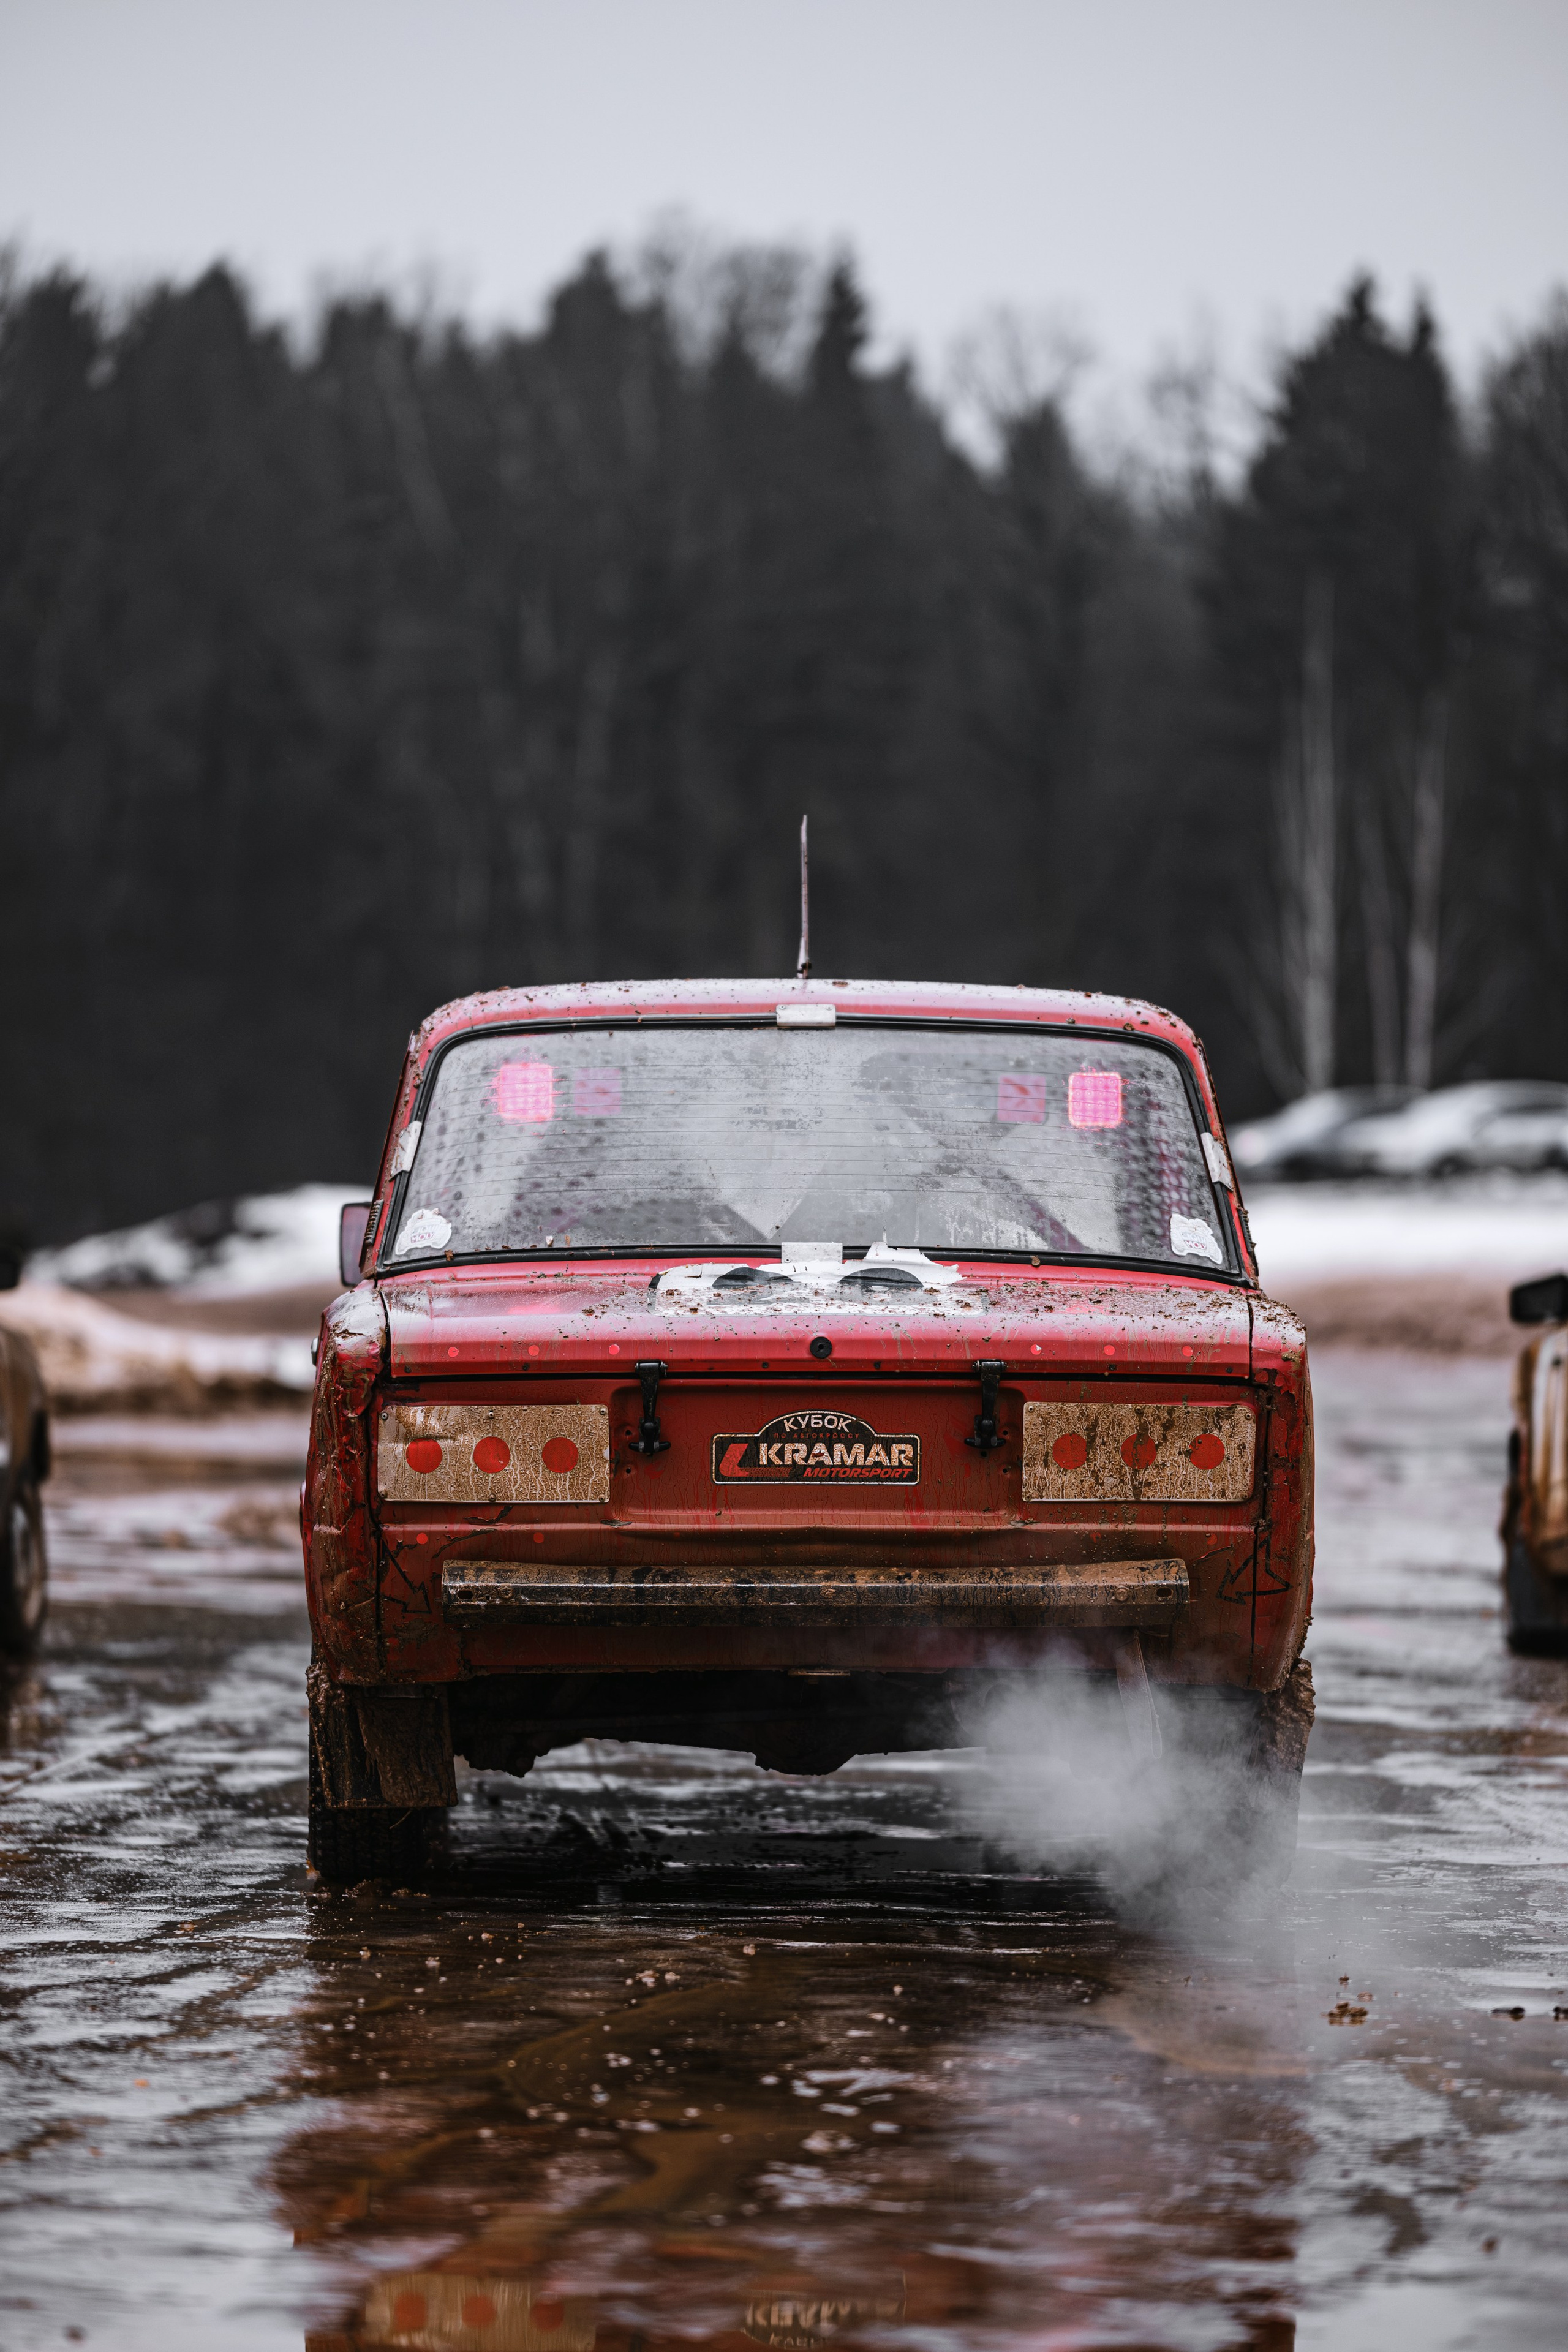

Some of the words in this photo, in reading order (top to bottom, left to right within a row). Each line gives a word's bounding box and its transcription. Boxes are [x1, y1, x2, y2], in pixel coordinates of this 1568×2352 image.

[1184, 1240, 1207, 1250] MOLY
[783, 1415, 852, 1432] КУБОК
[759, 1443, 914, 1466] KRAMAR
[803, 1468, 913, 1478] MOTORSPORT
